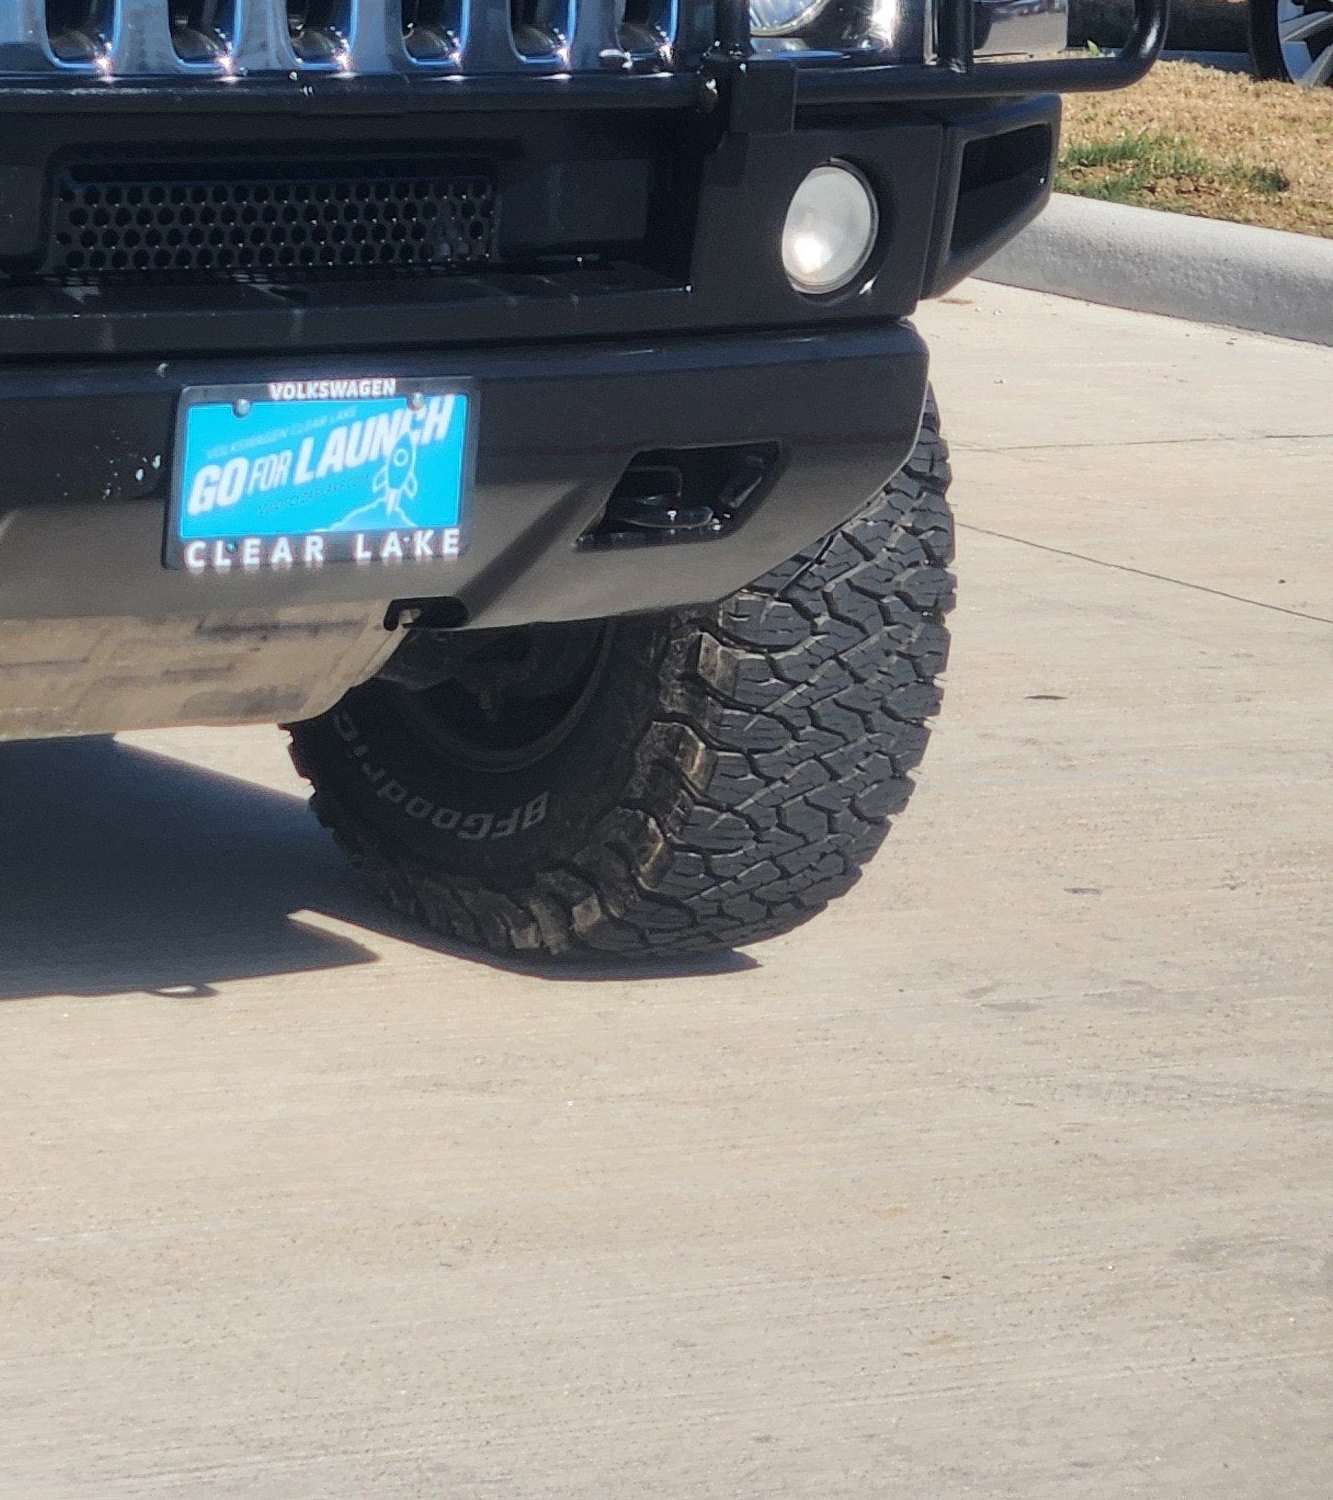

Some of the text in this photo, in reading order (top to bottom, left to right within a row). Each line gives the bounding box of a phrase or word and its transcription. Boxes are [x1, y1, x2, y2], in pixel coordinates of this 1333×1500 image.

[269, 378, 397, 400] VOLKSWAGEN
[187, 457, 249, 515] GO
[247, 450, 293, 496] FOR
[293, 395, 455, 486] LAUNCH
[184, 528, 461, 569] CLEAR LAKE
[332, 710, 550, 841] BFGoodric
